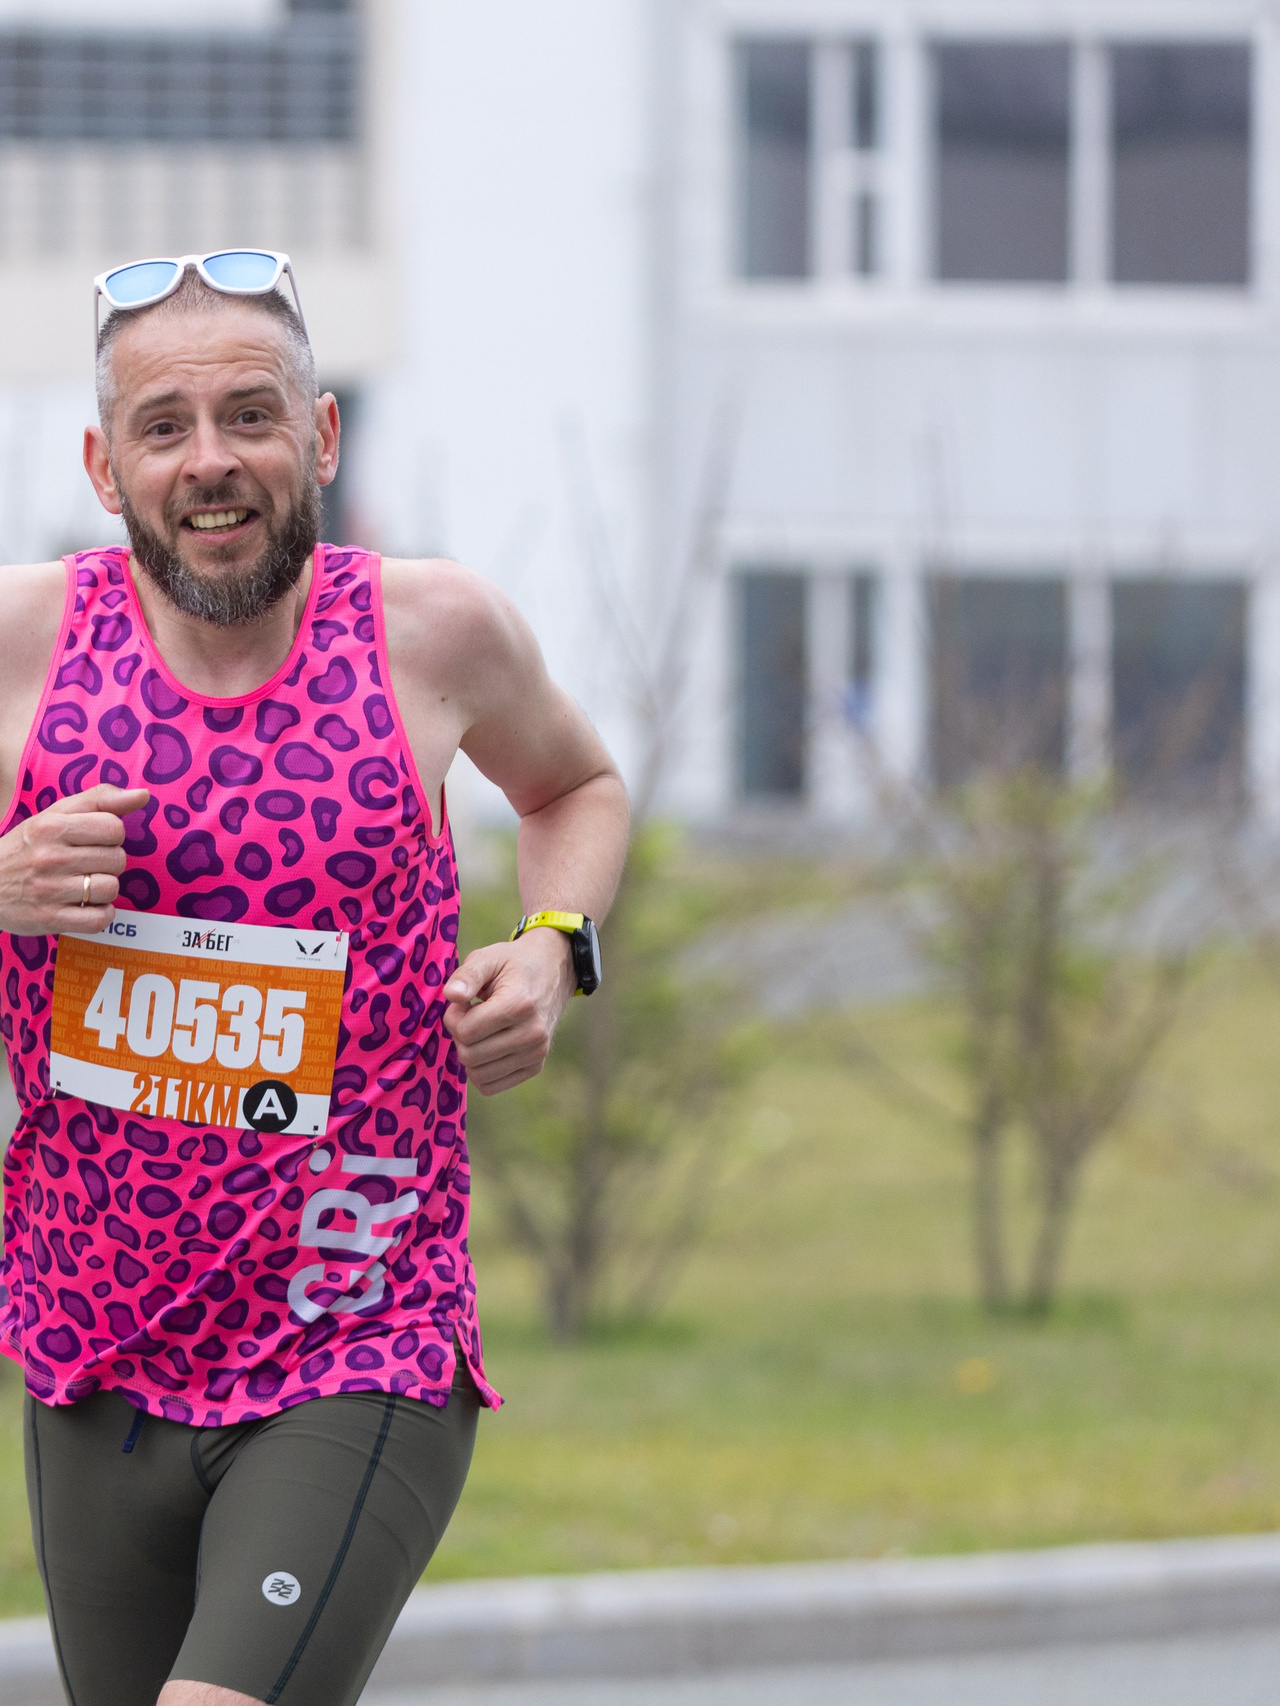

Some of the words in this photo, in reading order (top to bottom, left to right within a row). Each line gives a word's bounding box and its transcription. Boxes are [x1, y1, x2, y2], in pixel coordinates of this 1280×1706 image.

[198, 958, 223, 972] ПОКА
[222, 961, 239, 974] ВСЕ
[240, 963, 262, 976] СПЯТ
[280, 967, 306, 981] ЛЮБИ
[306, 969, 322, 982] БЕГ
[84, 967, 307, 1074] 40535
[89, 1050, 119, 1067] СТРЕСС
[119, 1056, 147, 1072] ДАВНО
[148, 1060, 180, 1077] ОТСТАЛ
[196, 1066, 238, 1086] ВЫБЕГАЮ
[238, 1073, 250, 1087] ЗА
